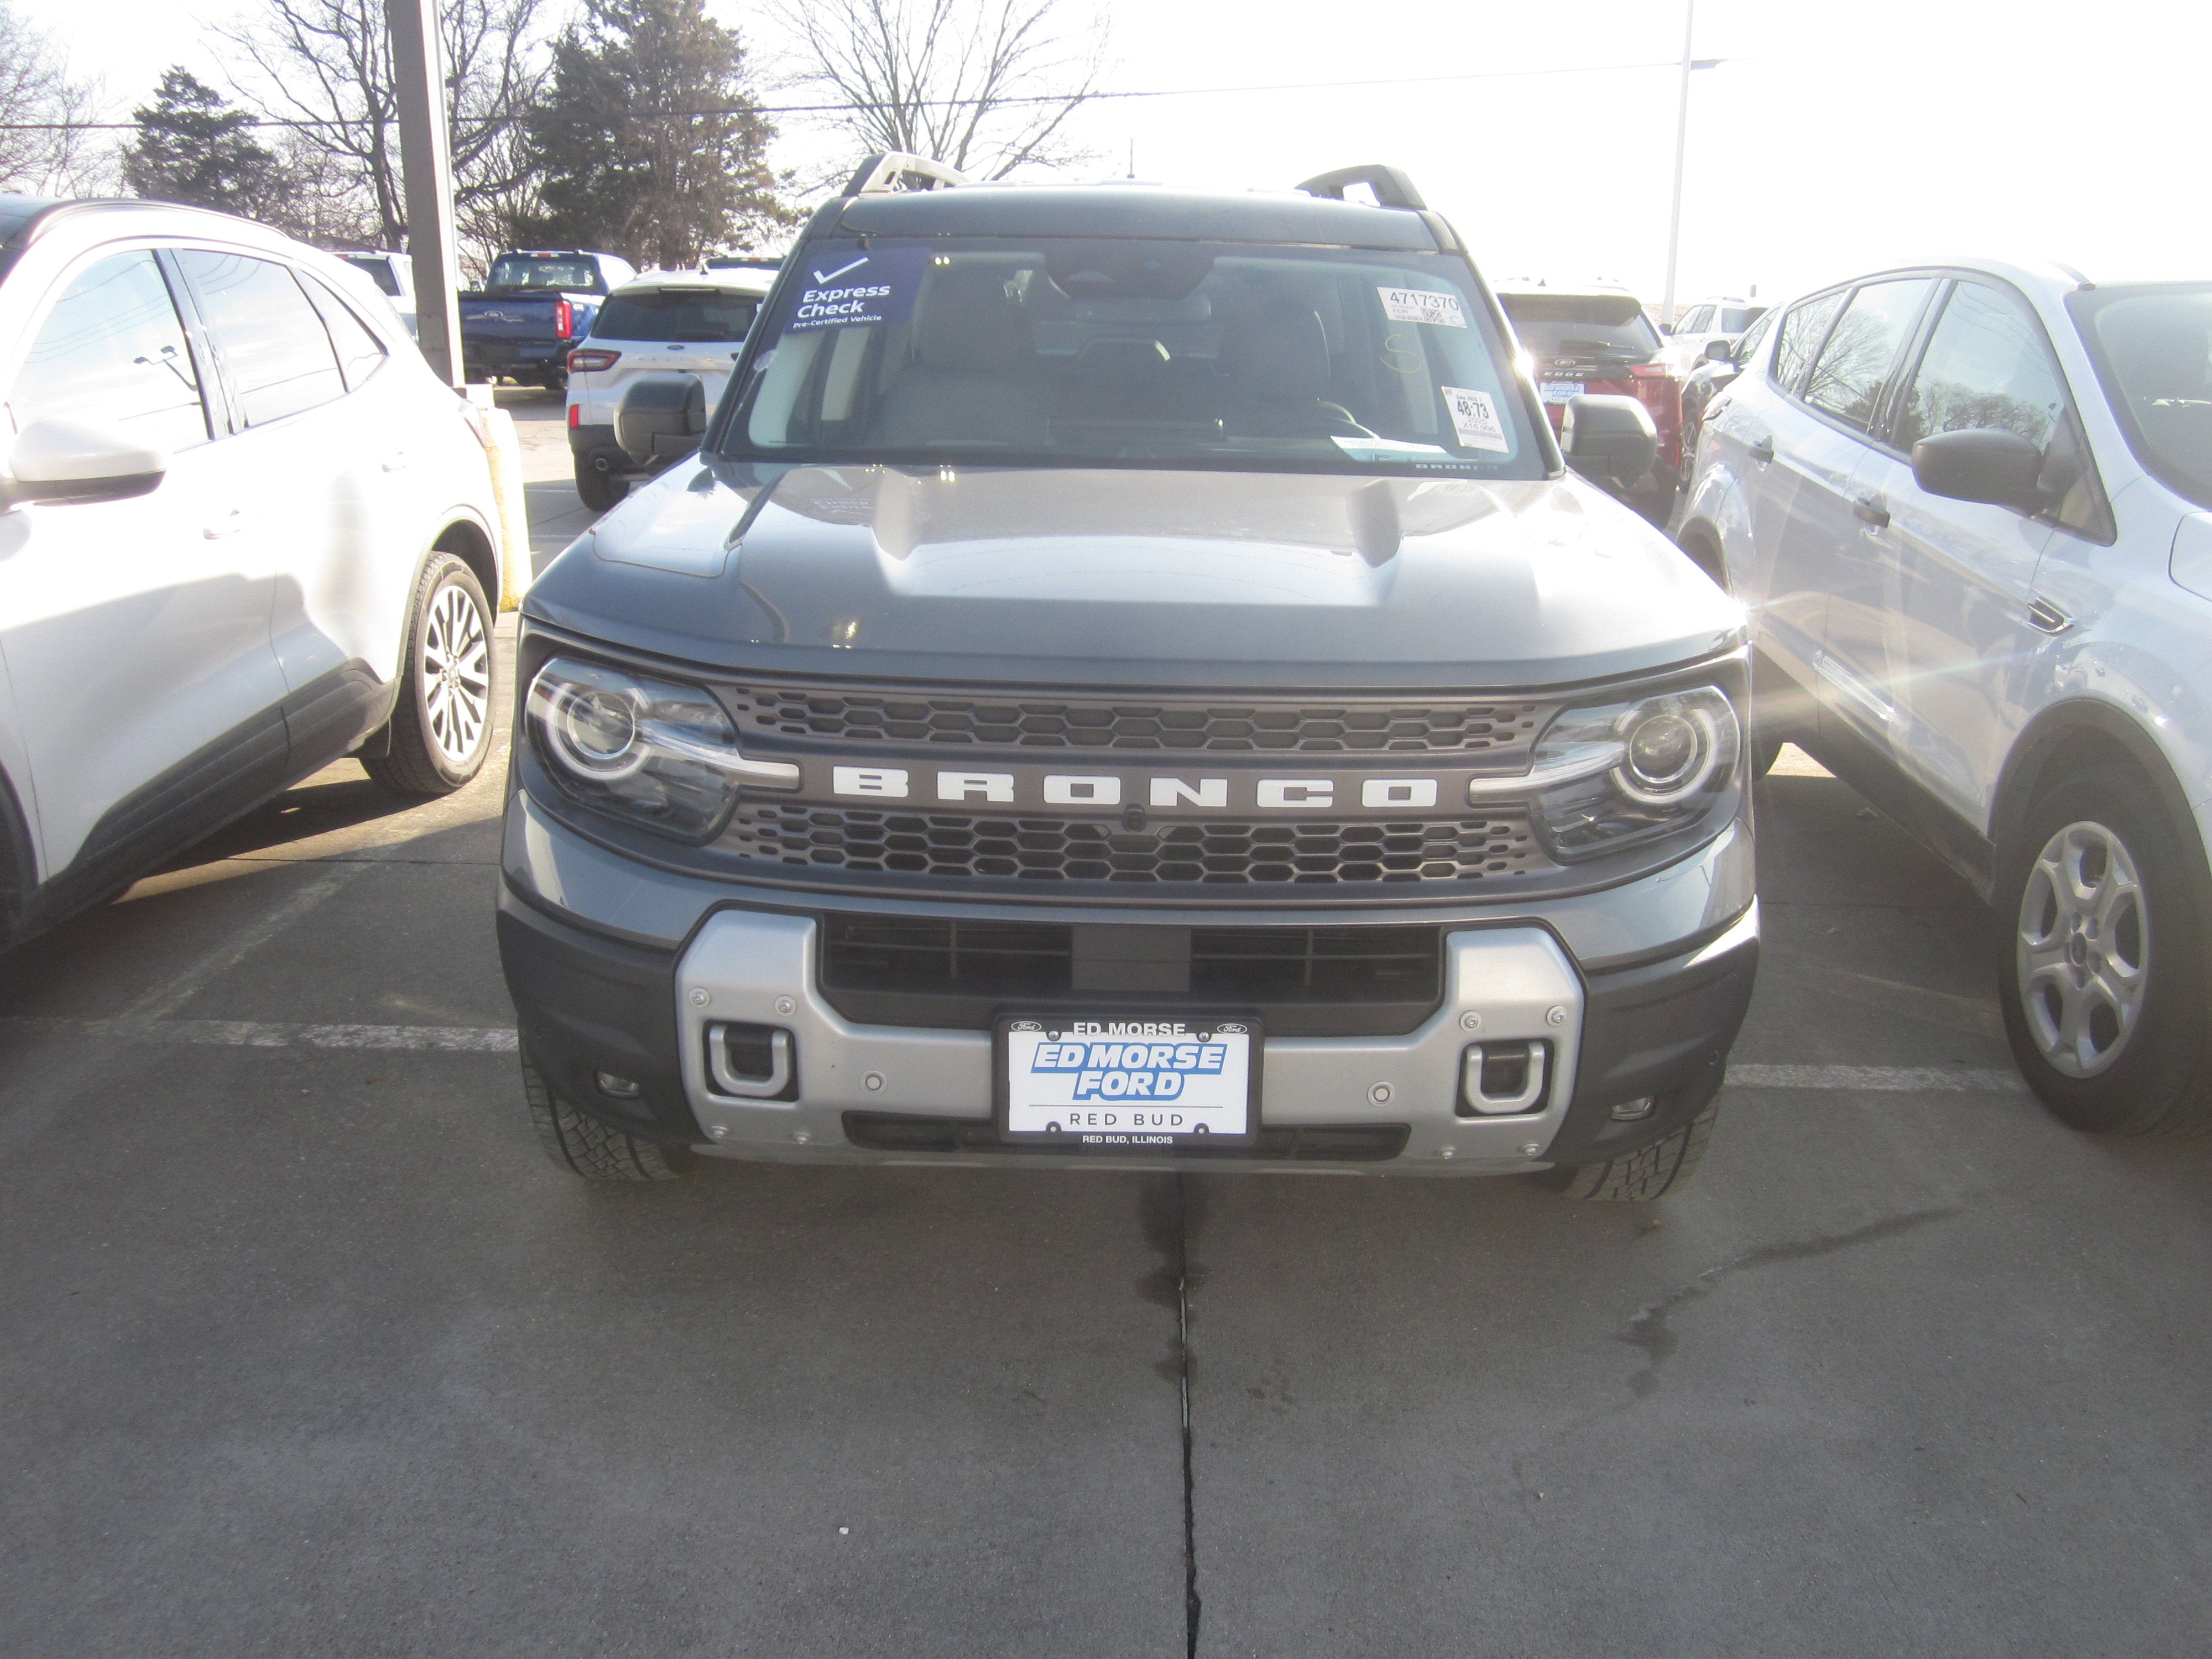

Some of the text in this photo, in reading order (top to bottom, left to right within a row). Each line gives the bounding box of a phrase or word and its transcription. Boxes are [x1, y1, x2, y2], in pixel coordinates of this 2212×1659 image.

[803, 285, 890, 302] Express
[1390, 291, 1459, 311] 4717370
[797, 300, 865, 319] Check
[792, 317, 848, 329] Pre-Certified
[1457, 400, 1489, 419] 48:73
[1467, 416, 1488, 425] 2025
[833, 765, 1437, 807] BRONCO
[1073, 1022, 1186, 1037] ED MORSE
[1034, 1044, 1225, 1070] ED MORSE
[1076, 1071, 1182, 1096] FORD
[1070, 1113, 1183, 1126] RED BUD
[1105, 1135, 1129, 1145] BUD,
[1132, 1135, 1173, 1144] ILLINOIS
